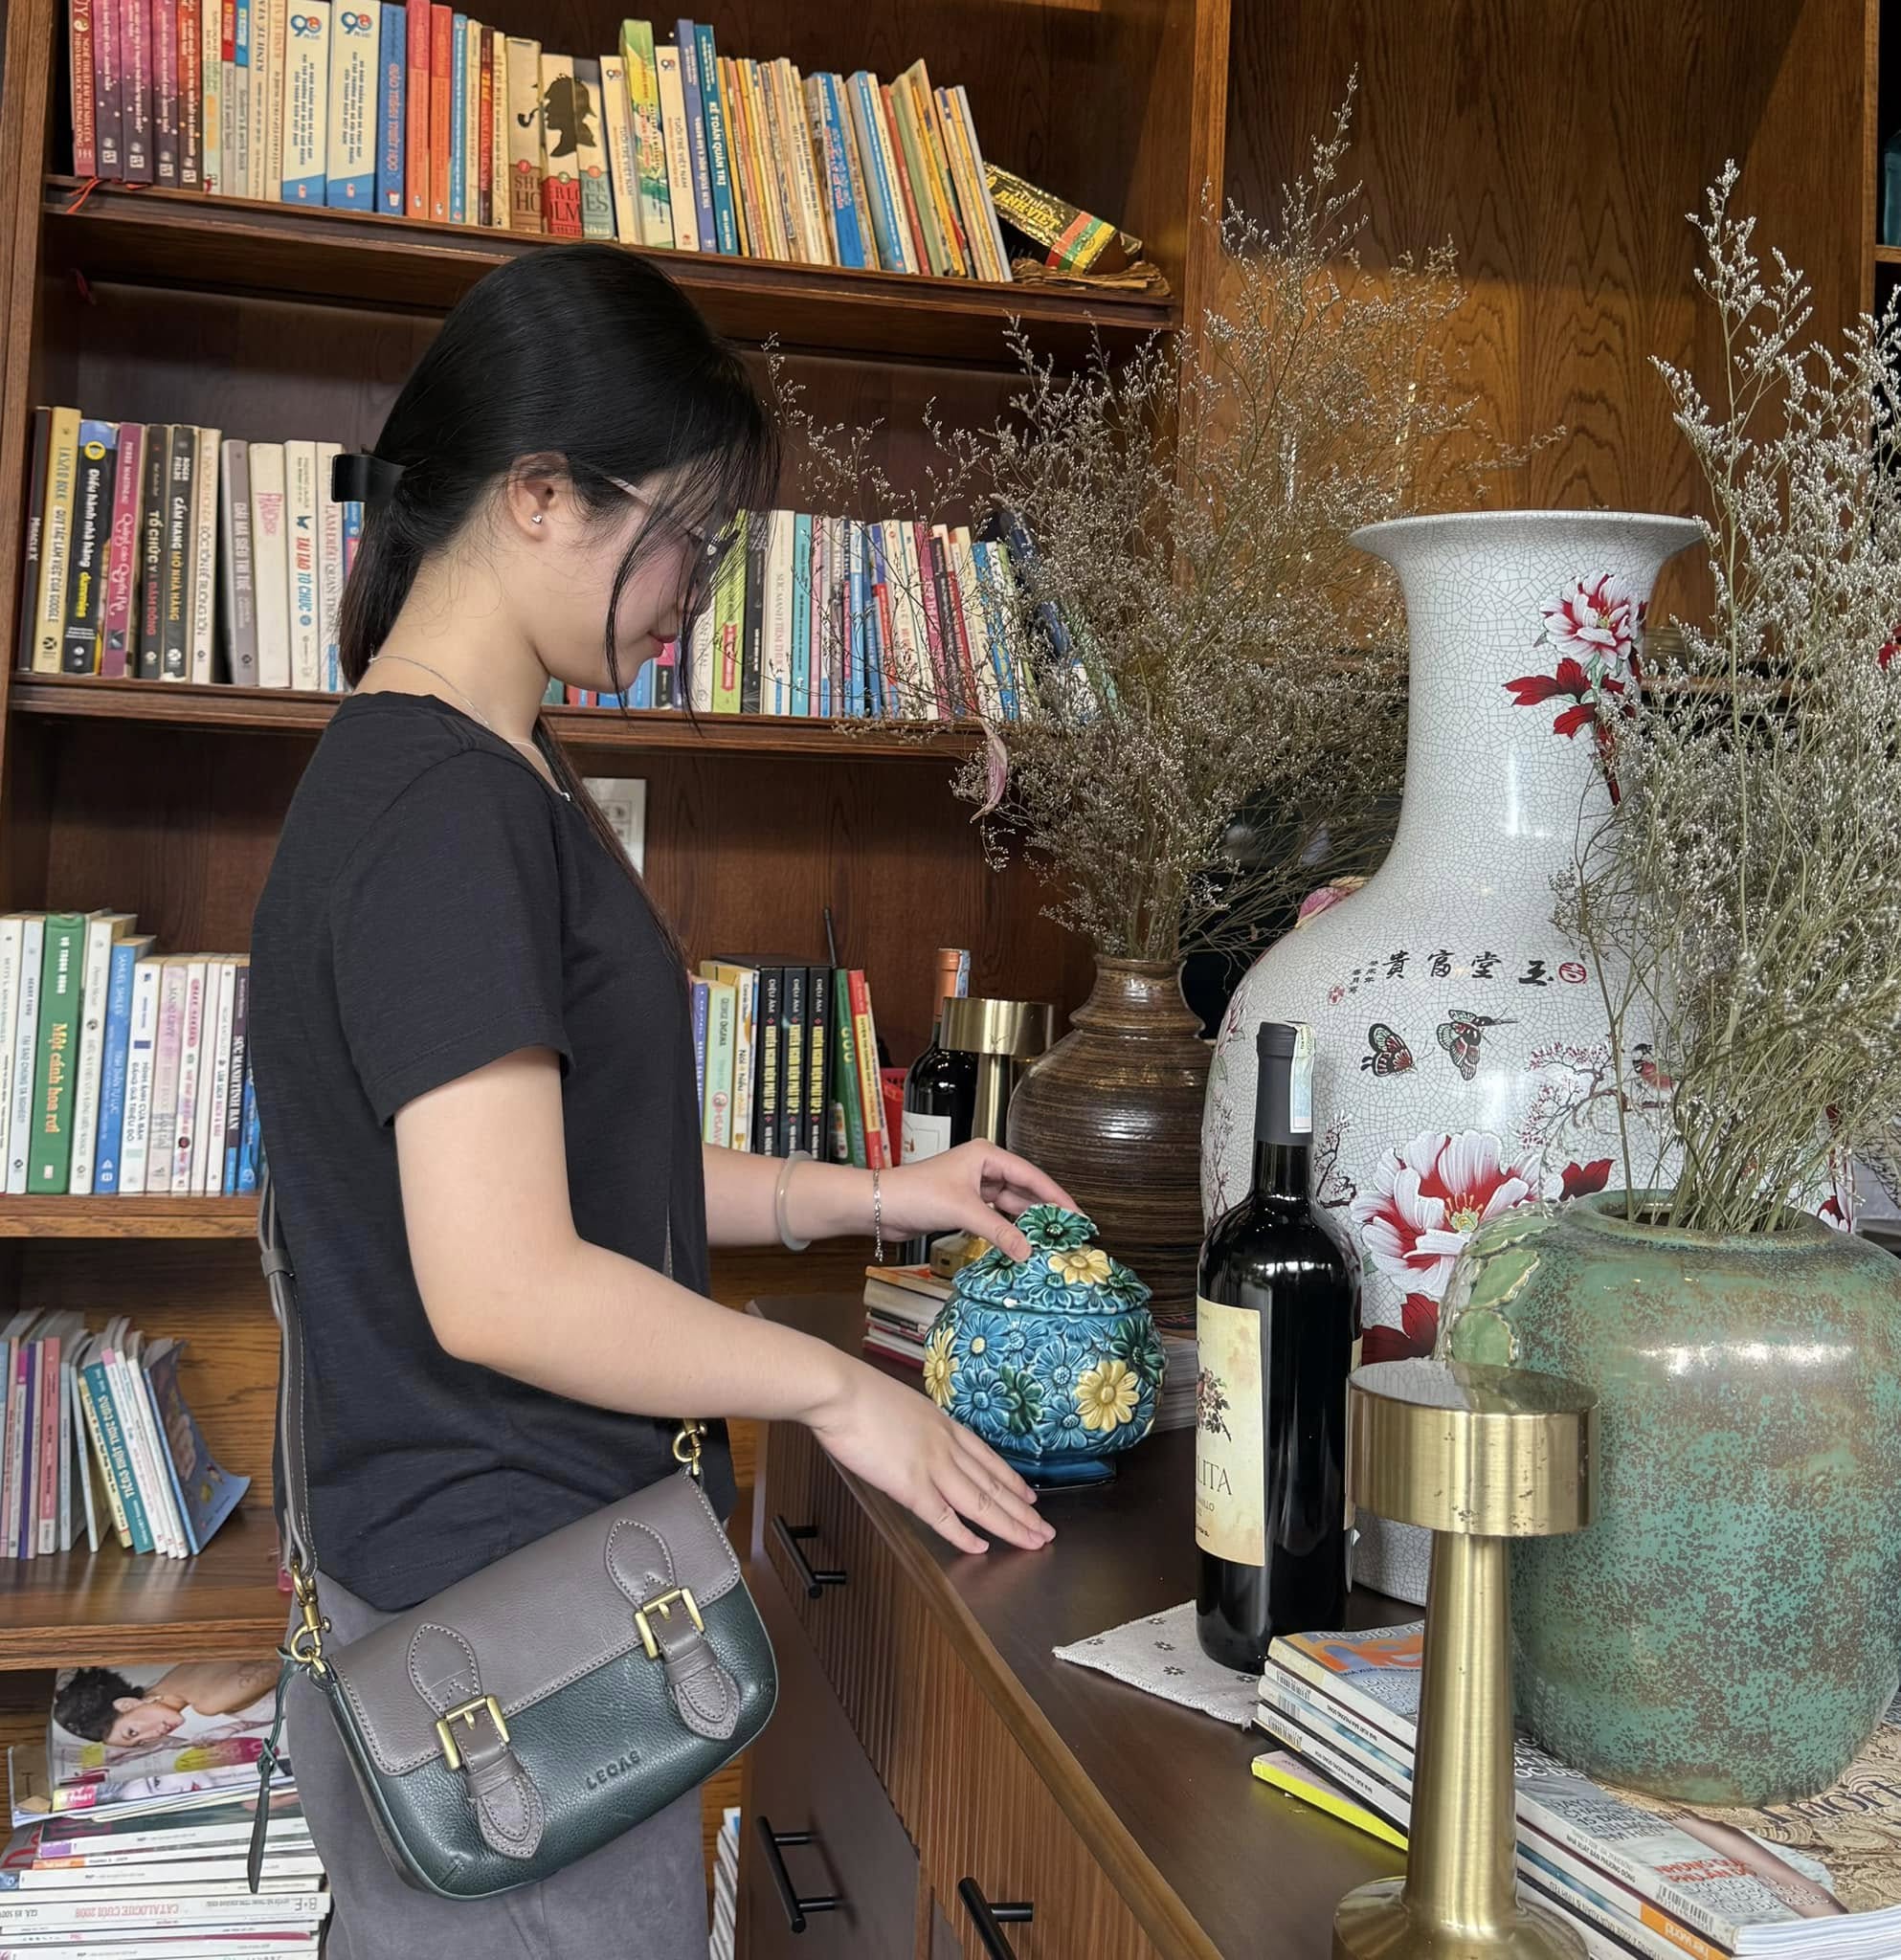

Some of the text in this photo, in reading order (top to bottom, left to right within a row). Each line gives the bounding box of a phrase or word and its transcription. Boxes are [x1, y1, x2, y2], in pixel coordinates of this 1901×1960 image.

[85, 494, 99, 519] hành
[147, 510, 165, 527] TỔ
[83, 520, 96, 541] nhà
[171, 521, 184, 549] NANG
[78, 541, 95, 568] hàng
[147, 528, 162, 564] CHỨC
[170, 568, 183, 591] NHÀ
[168, 591, 182, 620] HÀNG
[44, 1022, 69, 1133] Một cánh hoa rơi
[586, 1749, 640, 1791] LEGAS
